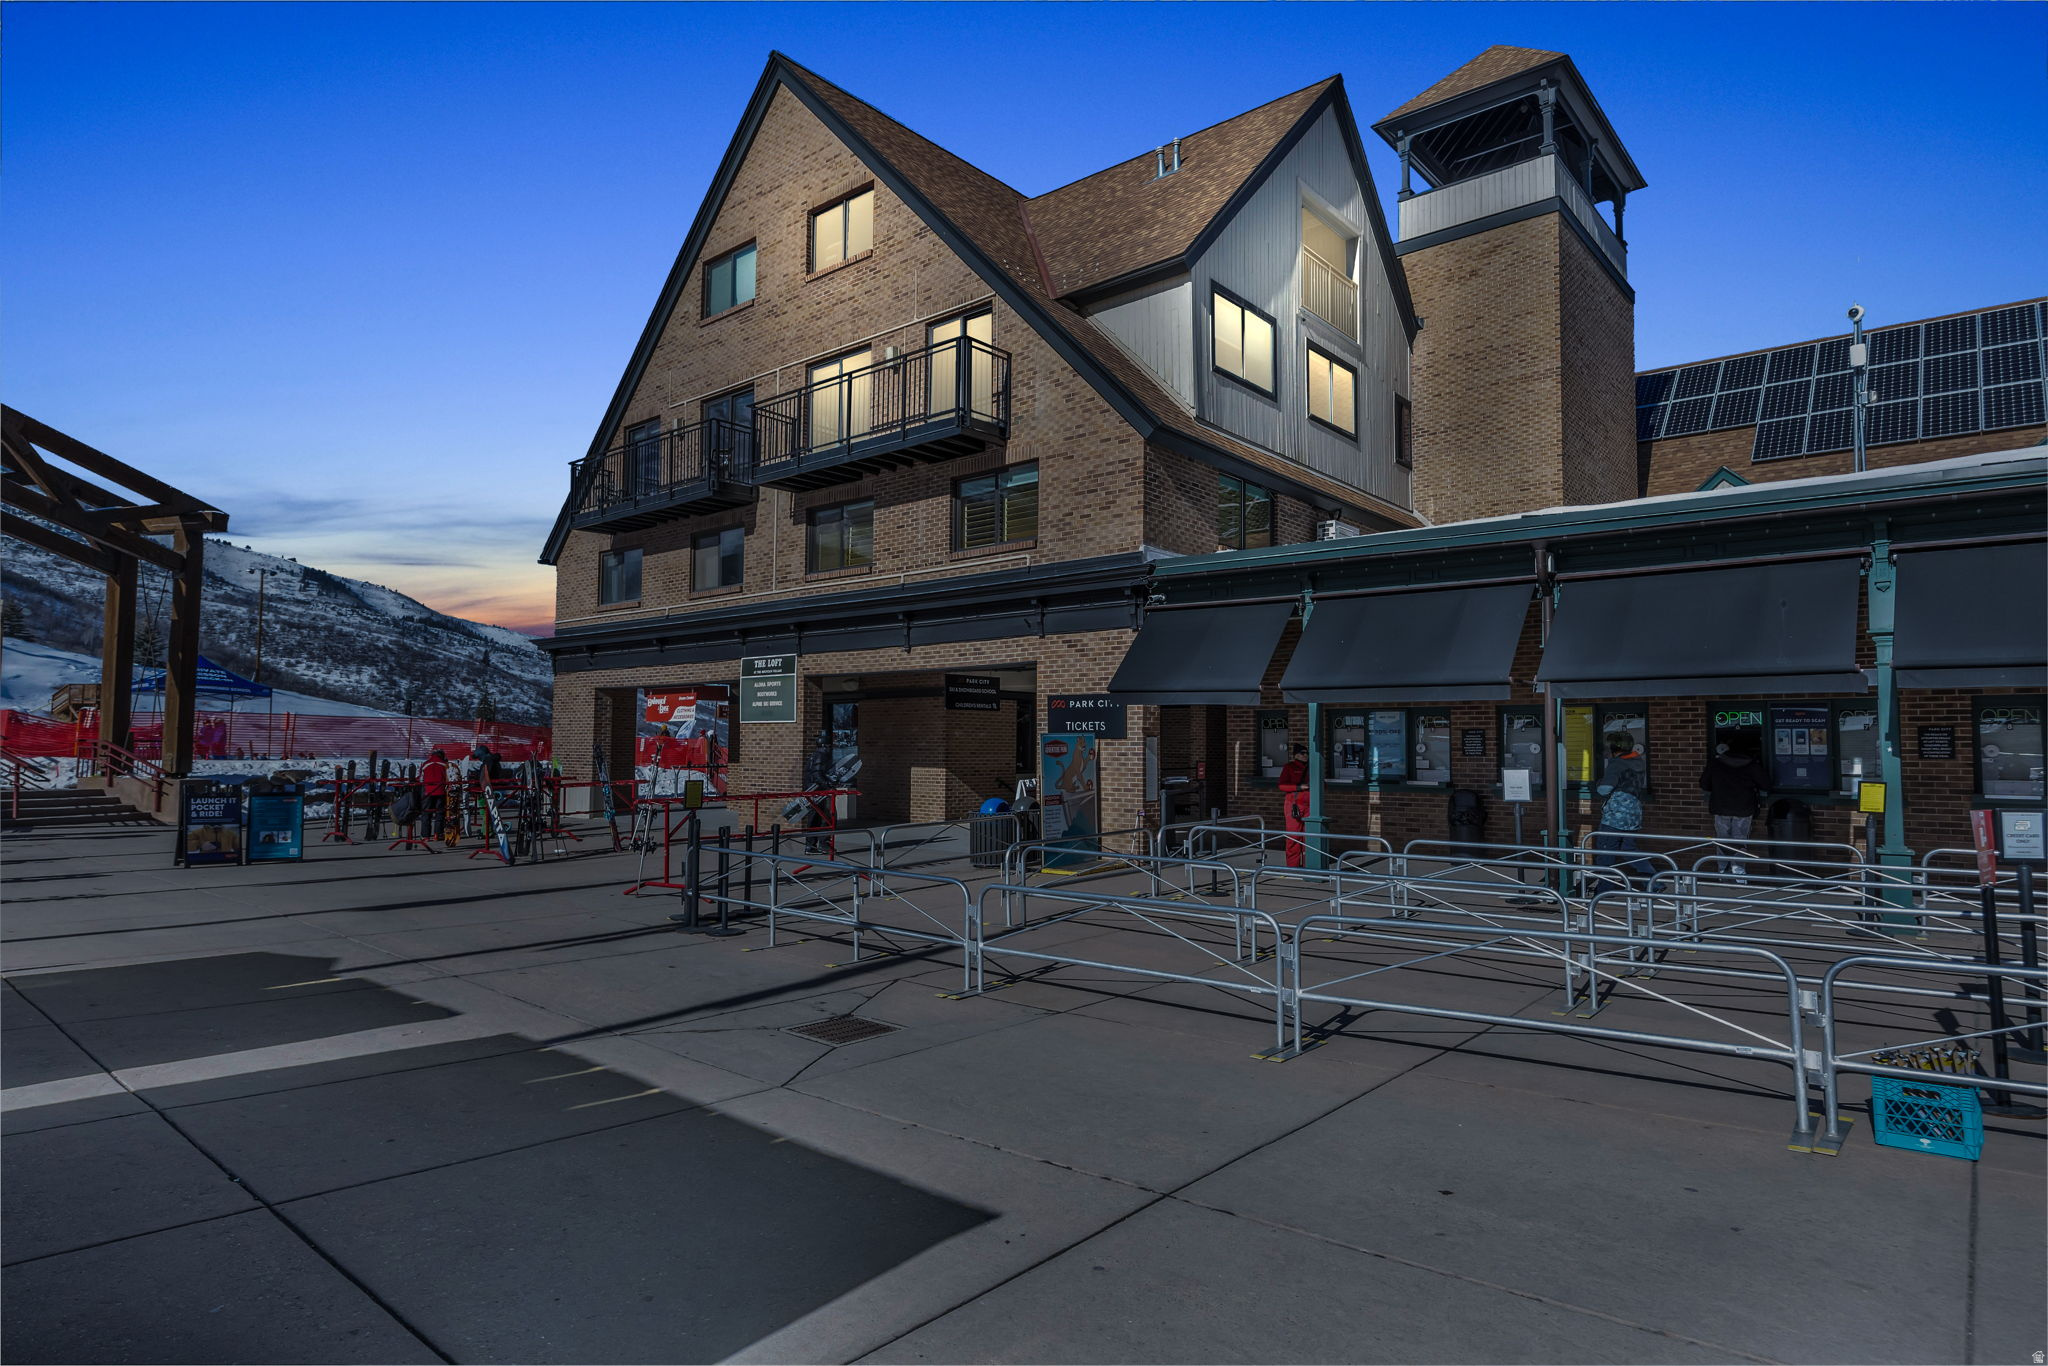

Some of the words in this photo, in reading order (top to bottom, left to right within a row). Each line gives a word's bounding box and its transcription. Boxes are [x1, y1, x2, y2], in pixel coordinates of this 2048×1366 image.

[754, 659, 767, 668] THE
[768, 658, 783, 667] LOFT
[1069, 700, 1094, 708] PARK
[1097, 699, 1120, 708] CI
[1716, 711, 1762, 726] OPEN
[1981, 708, 2041, 723] OPEN
[1065, 721, 1106, 731] TICKETS
[191, 797, 228, 805] LAUNCH
[485, 785, 506, 847] CAPITA
